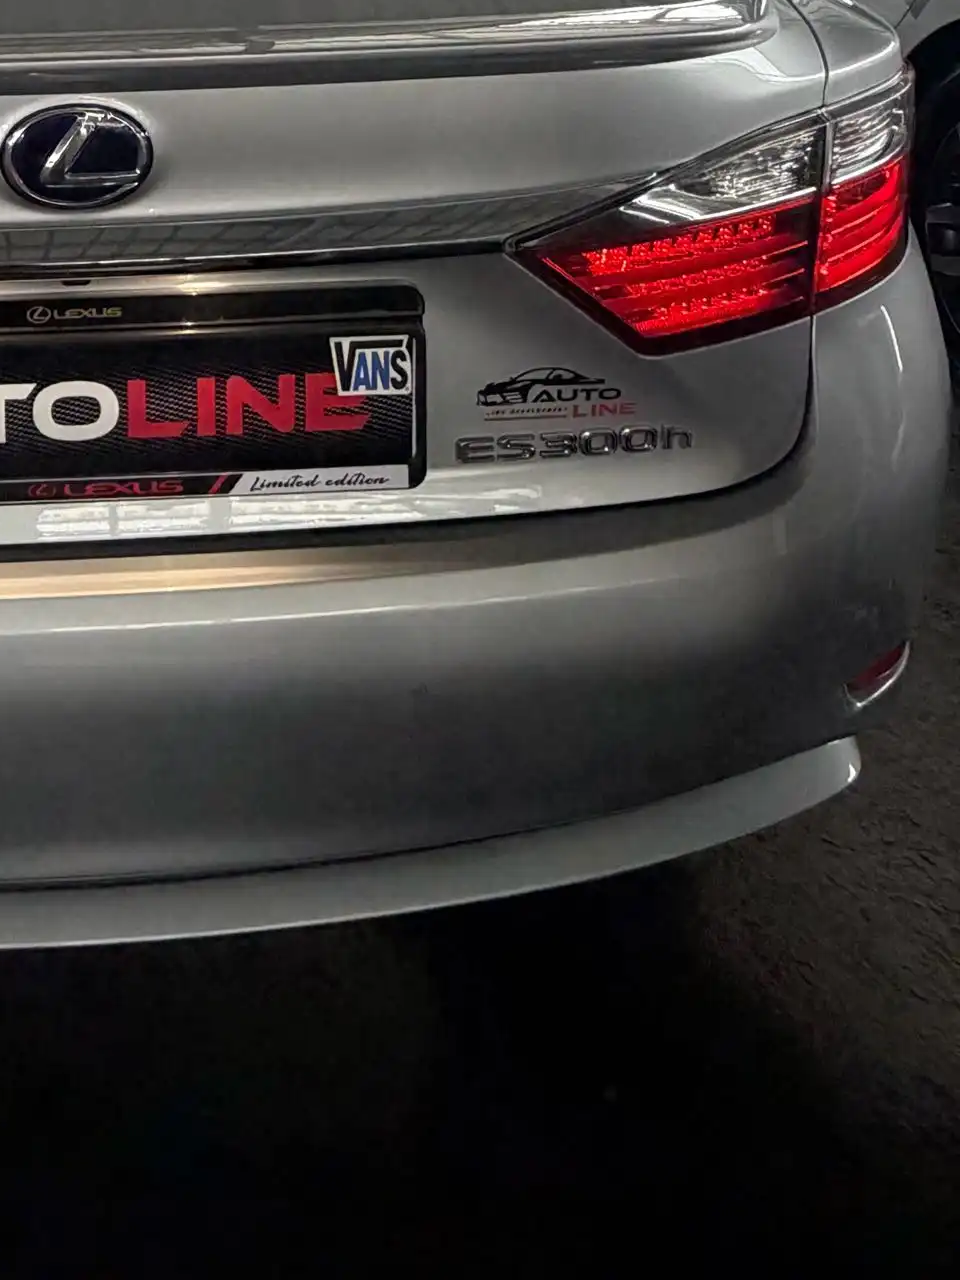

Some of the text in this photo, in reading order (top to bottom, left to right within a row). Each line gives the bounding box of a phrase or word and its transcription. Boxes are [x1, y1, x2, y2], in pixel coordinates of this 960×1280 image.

[53, 306, 123, 320] LEXUS
[334, 339, 409, 392] VANS
[533, 387, 622, 403] AUTO
[573, 402, 637, 418] LINE
[455, 423, 693, 464] ES300h
[63, 479, 185, 498] LEXUS
[249, 472, 390, 492] Limited edition
